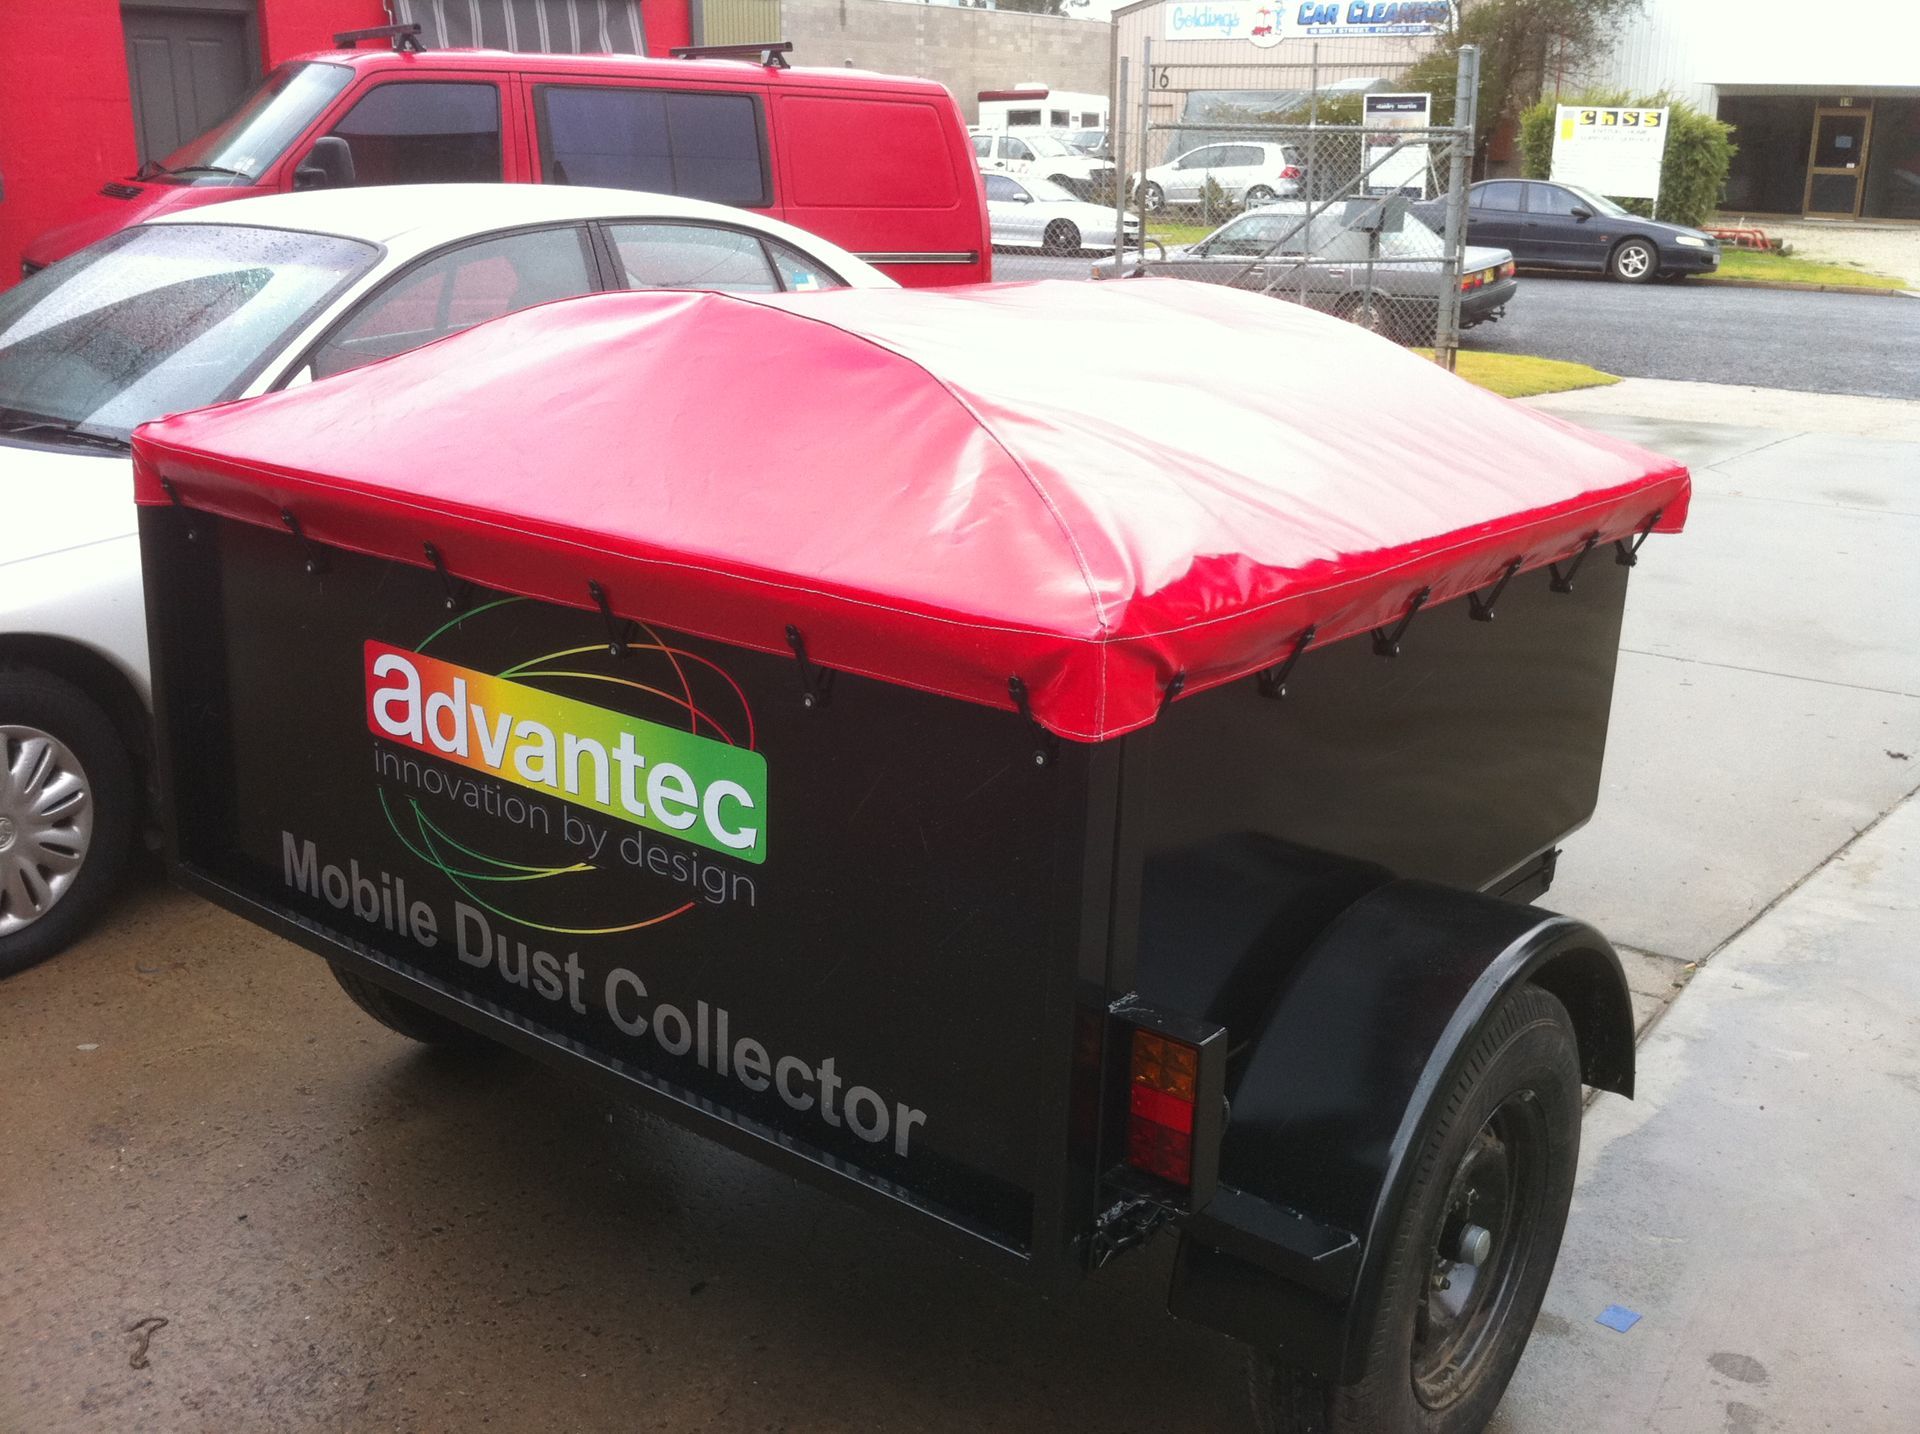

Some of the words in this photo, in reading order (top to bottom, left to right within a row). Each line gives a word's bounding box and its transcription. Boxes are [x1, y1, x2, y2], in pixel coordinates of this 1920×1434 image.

[1151, 64, 1170, 89] 16
[1297, 1, 1340, 25] CAR
[372, 653, 758, 850] advantec
[374, 742, 549, 834] innovation
[563, 805, 607, 860] by
[620, 832, 757, 907] design
[281, 831, 440, 949] Mobile
[455, 900, 588, 1015] Dust
[605, 967, 928, 1159] Collector
